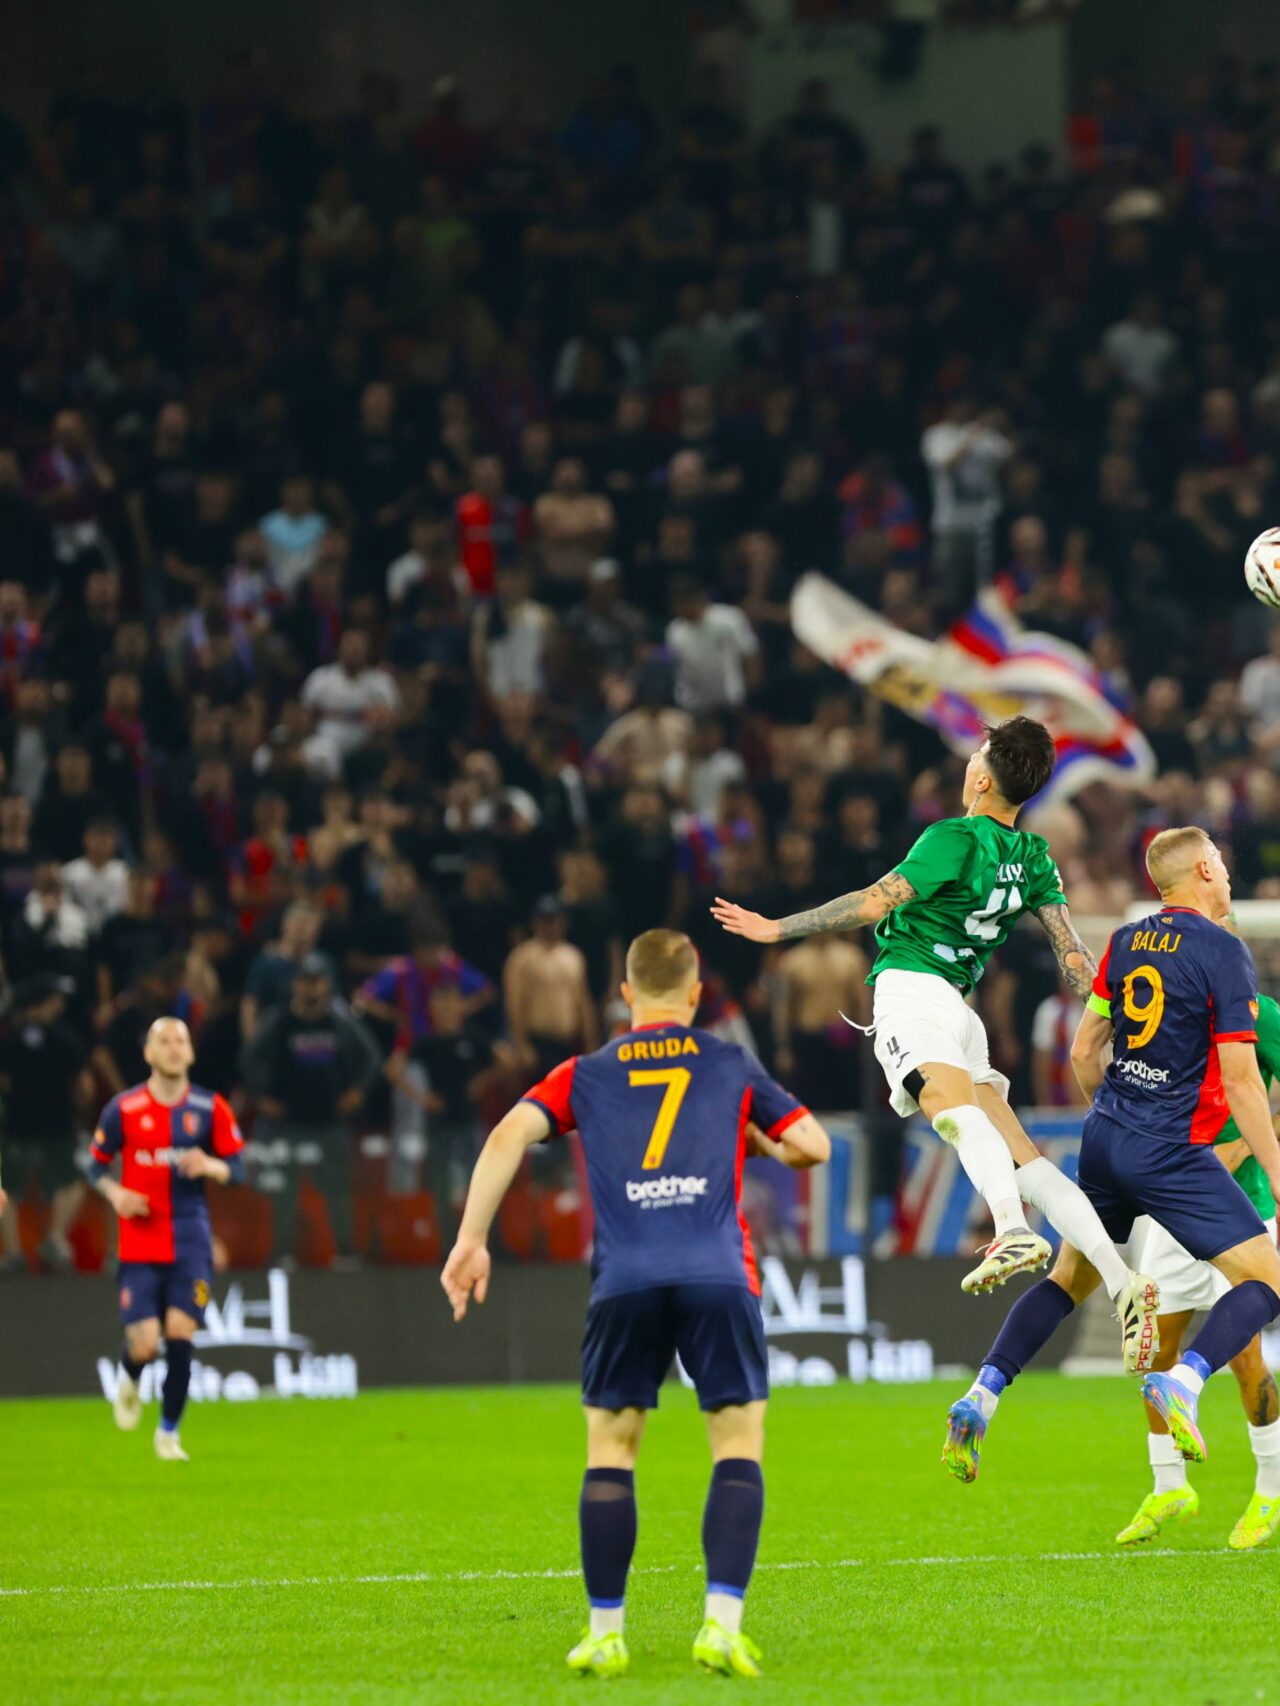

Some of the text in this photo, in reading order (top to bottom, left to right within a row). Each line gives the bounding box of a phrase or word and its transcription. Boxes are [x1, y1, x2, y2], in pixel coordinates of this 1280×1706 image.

[964, 885, 1022, 940] 4
[1131, 931, 1182, 953] BALAJ
[1122, 965, 1165, 1049] 9
[618, 1036, 699, 1062] GRUDA
[886, 1036, 900, 1056] 4
[628, 1067, 692, 1170] 7
[626, 1175, 709, 1202] brother
